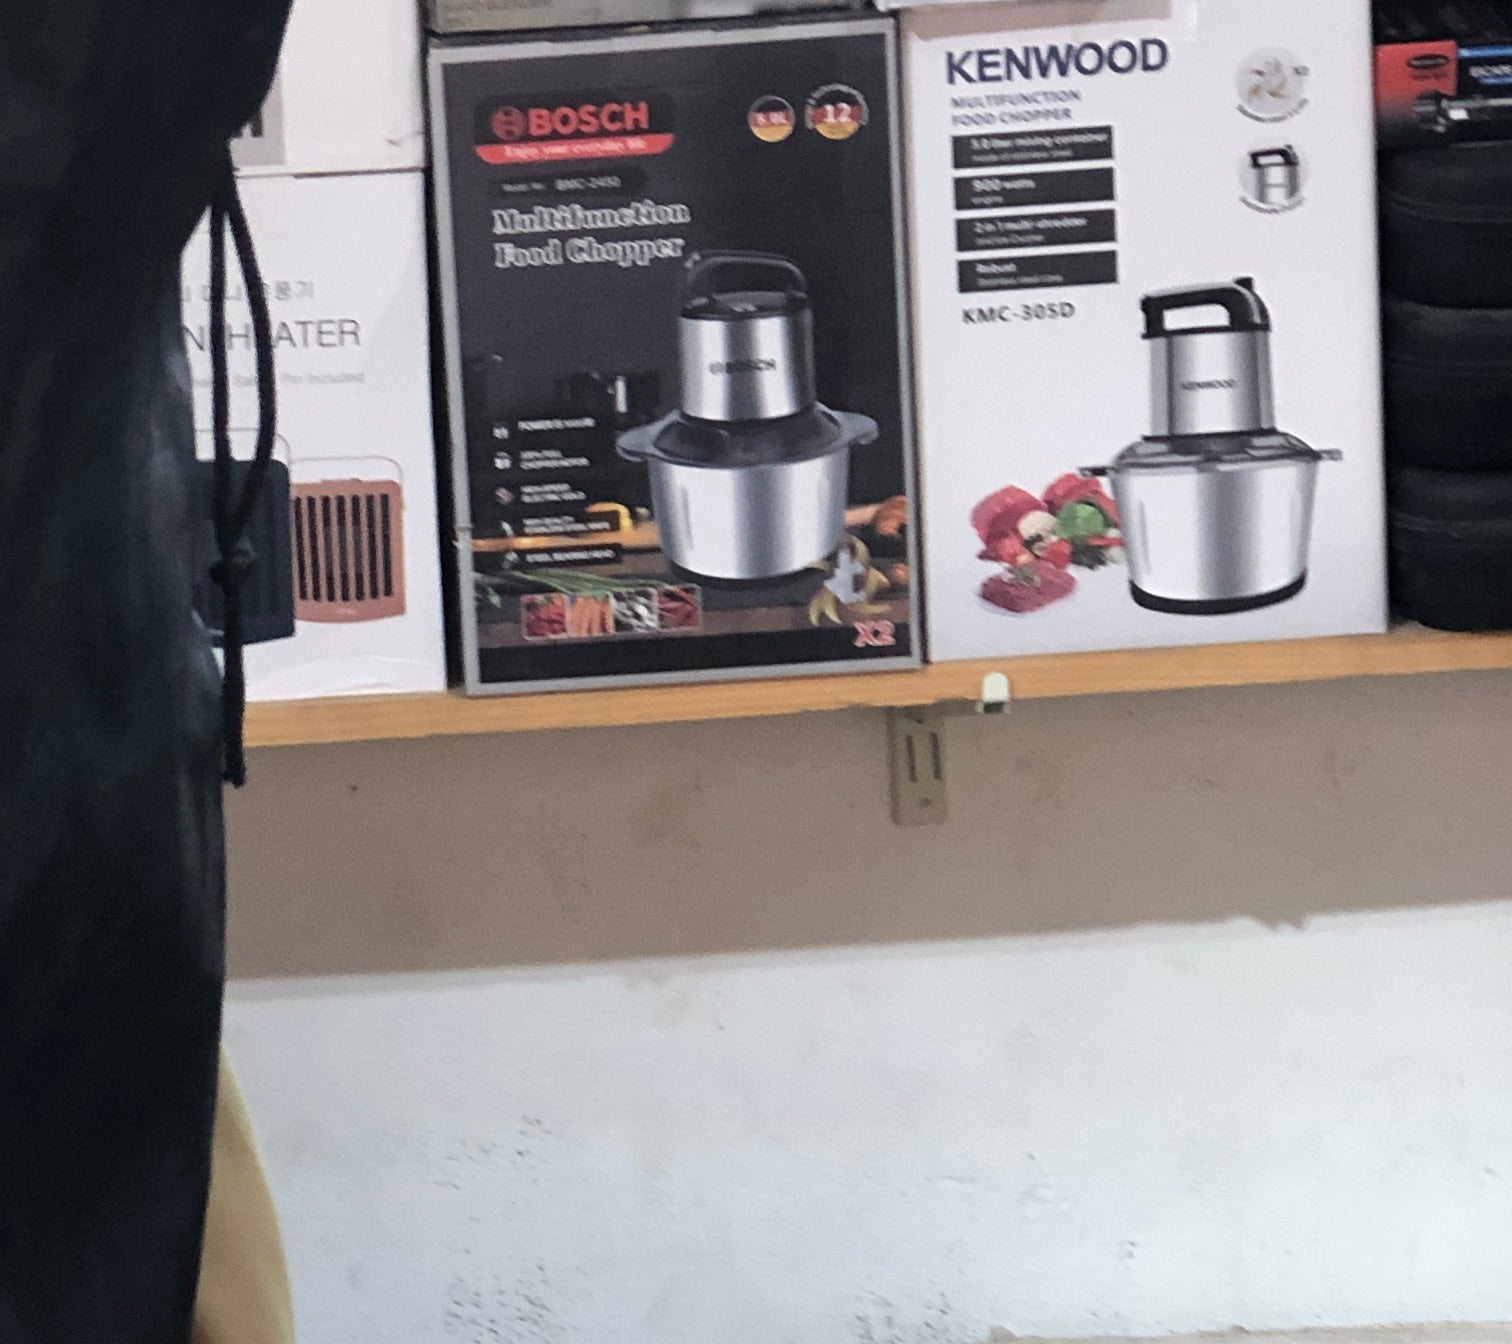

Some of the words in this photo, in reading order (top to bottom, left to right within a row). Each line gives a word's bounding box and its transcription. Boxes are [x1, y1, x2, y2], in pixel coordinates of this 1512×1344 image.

[946, 38, 1168, 85] KENWOOD
[528, 100, 649, 136] BOSCH
[824, 102, 851, 123] 12
[492, 198, 692, 236] Multifunction
[493, 238, 564, 269] Food
[565, 236, 686, 269] Chopper
[227, 318, 361, 352] HATER
